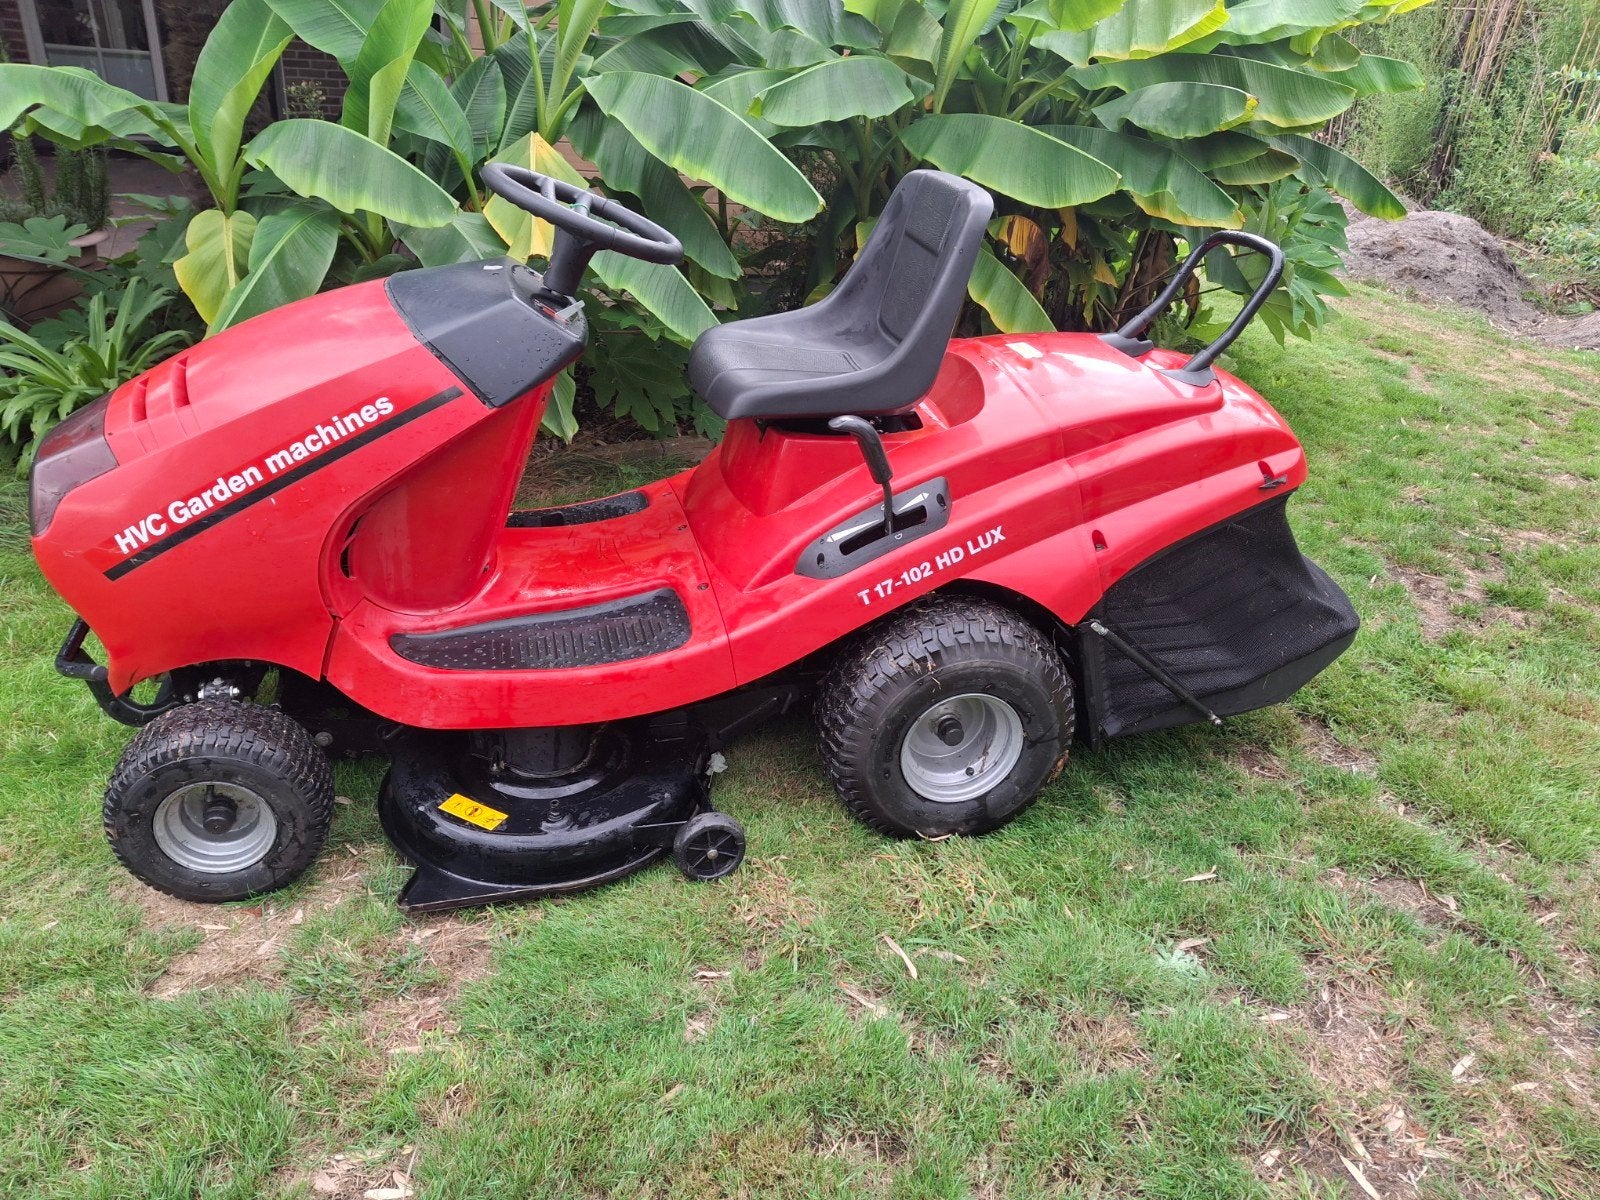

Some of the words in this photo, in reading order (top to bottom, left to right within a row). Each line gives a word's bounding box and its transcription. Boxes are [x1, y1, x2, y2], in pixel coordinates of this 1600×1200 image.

[114, 514, 167, 554] HVC
[167, 466, 263, 524] Garden
[264, 397, 394, 474] machines
[857, 589, 871, 606] T
[874, 562, 934, 598] 17-102
[934, 546, 965, 570] HD
[967, 526, 1006, 555] LUX
